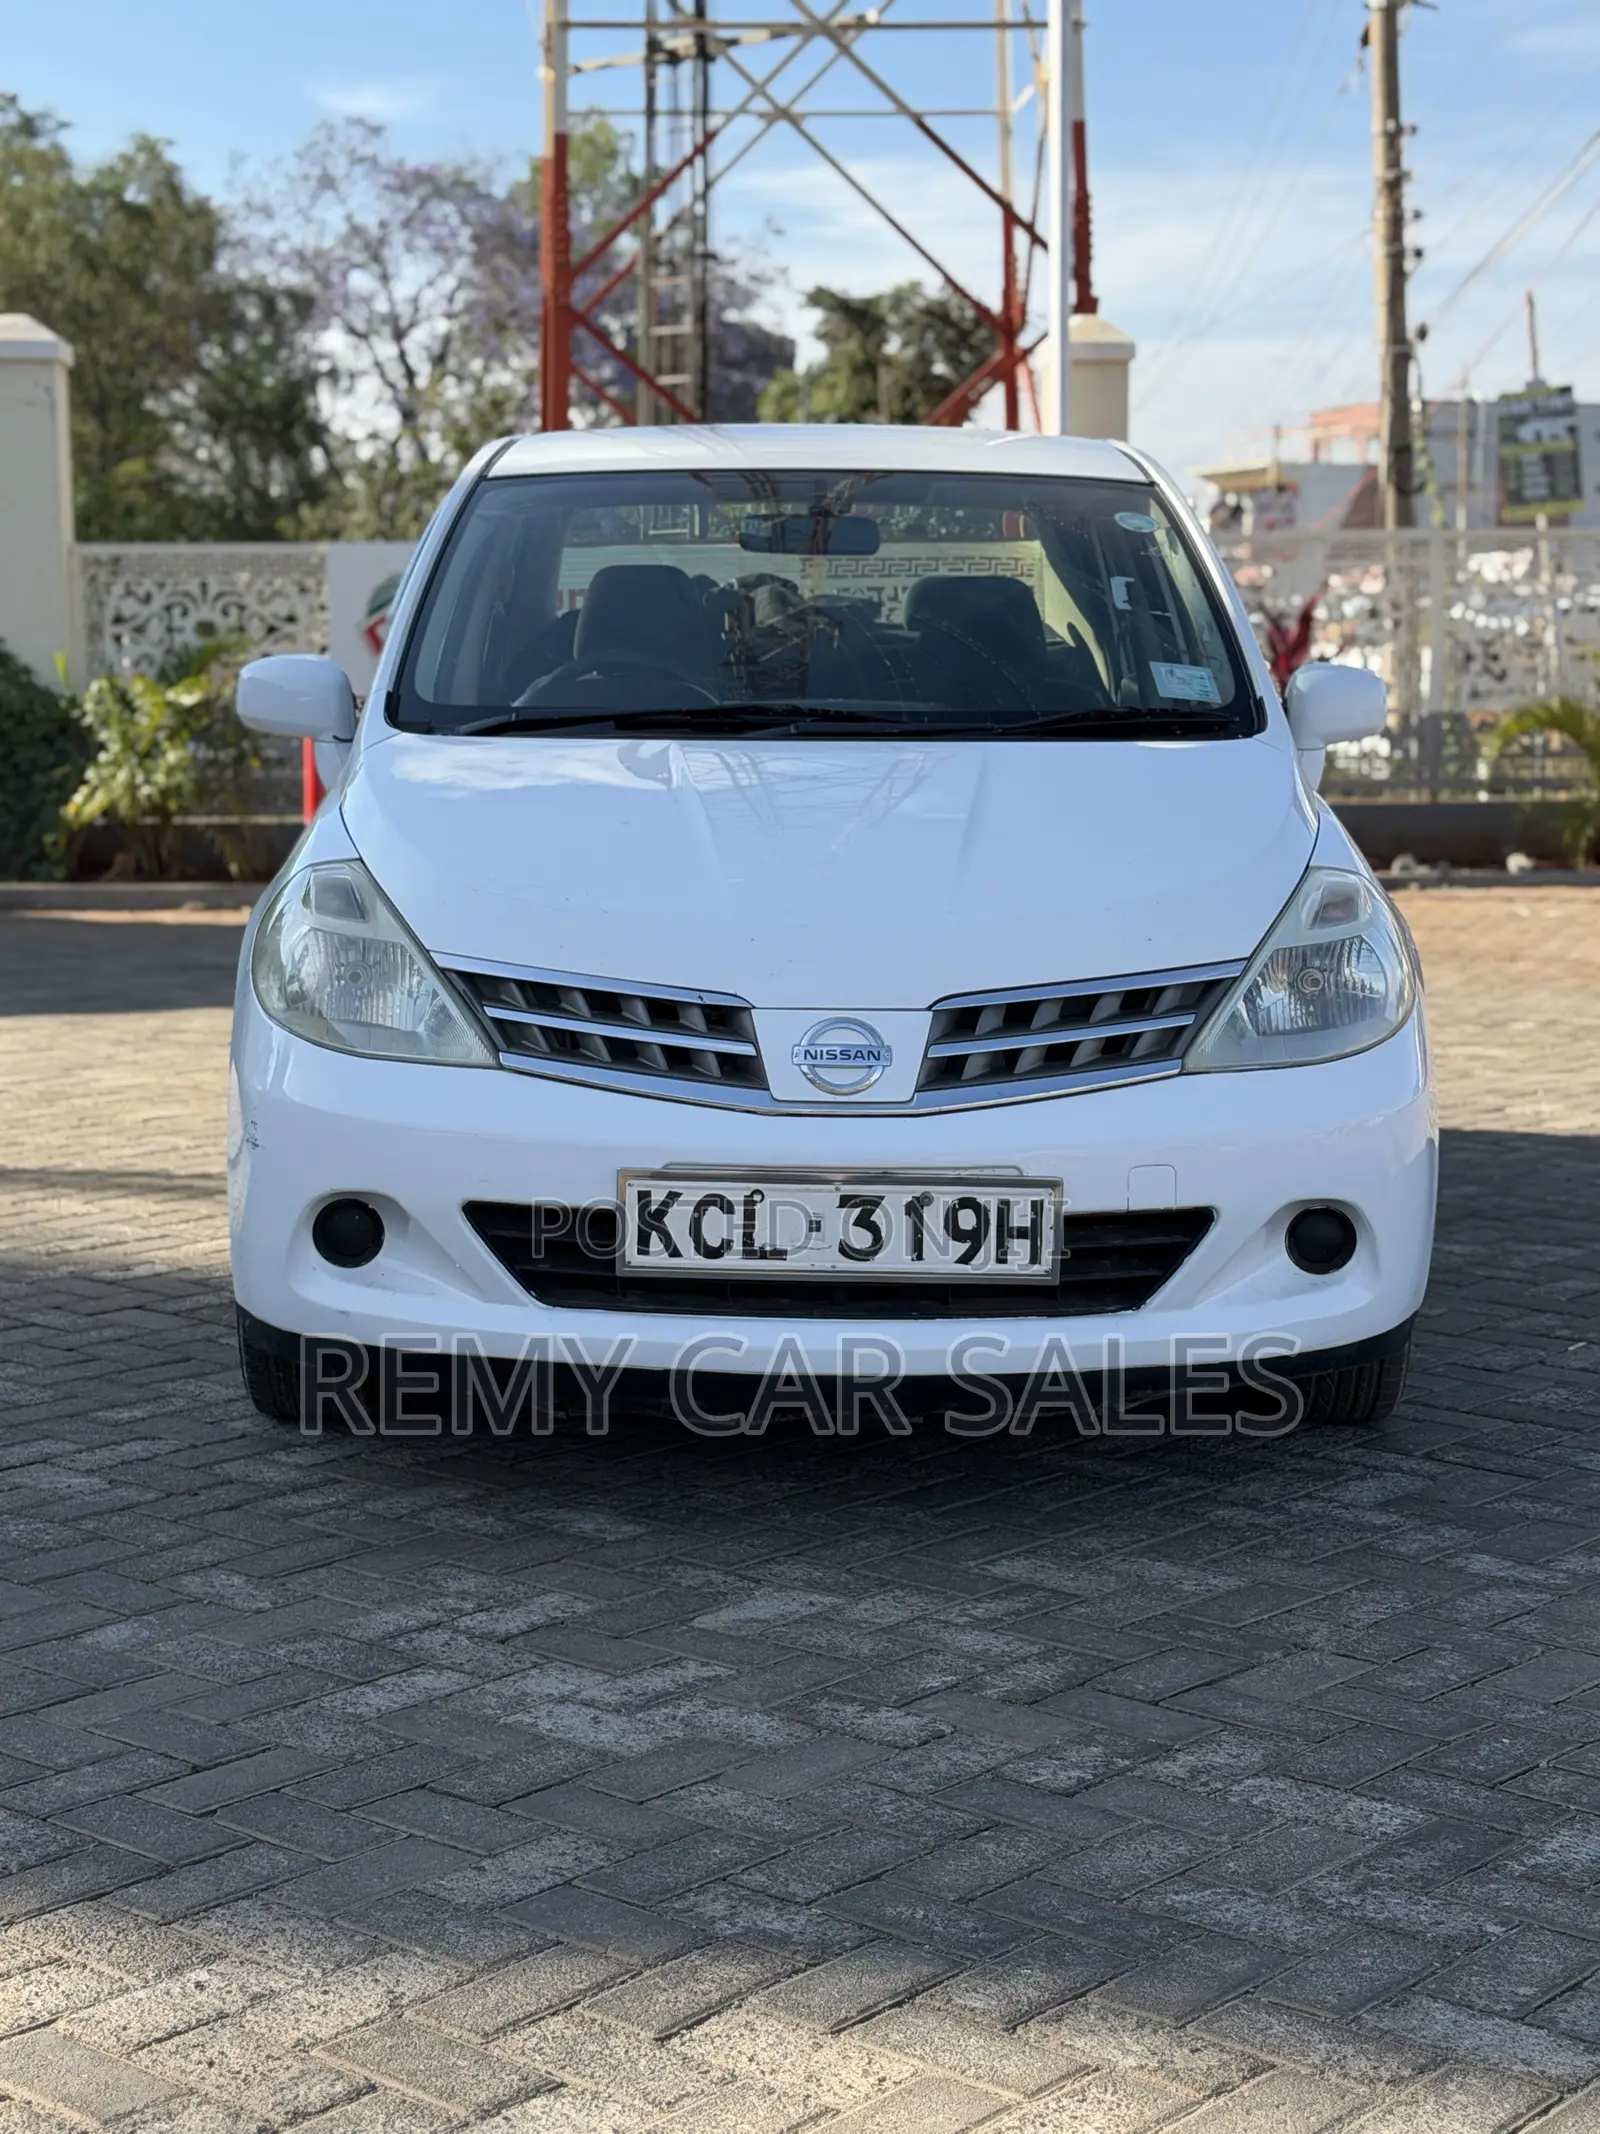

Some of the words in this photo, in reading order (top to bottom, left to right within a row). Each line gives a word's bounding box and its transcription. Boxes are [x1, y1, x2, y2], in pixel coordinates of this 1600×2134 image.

[804, 1049, 881, 1061] NISSAN
[636, 1189, 788, 1260] KCL
[836, 1194, 1043, 1265] 319H
